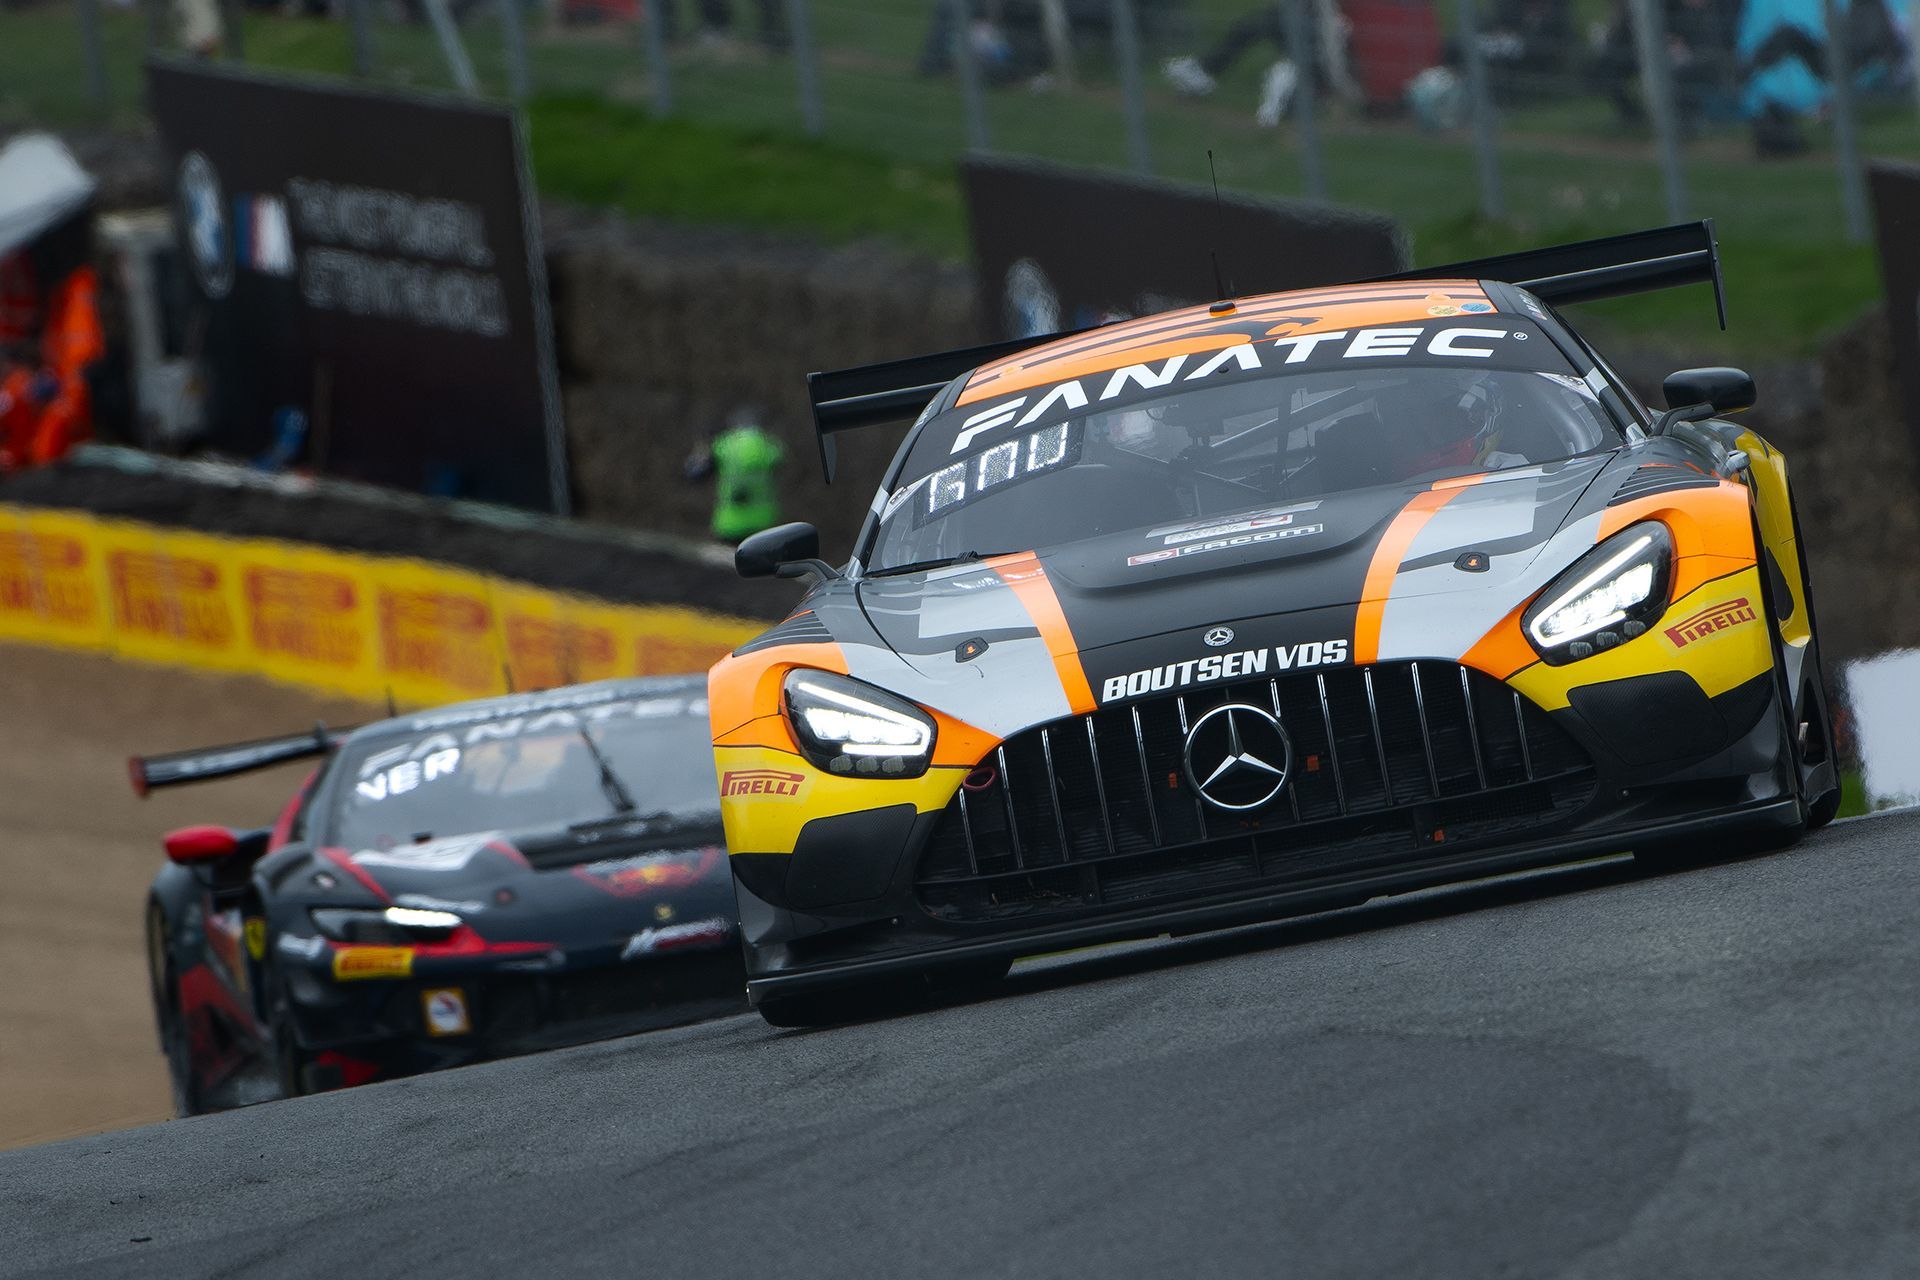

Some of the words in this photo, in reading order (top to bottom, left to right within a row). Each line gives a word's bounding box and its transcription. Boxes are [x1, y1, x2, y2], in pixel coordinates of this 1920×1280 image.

[1664, 597, 1757, 648] PIRELLI
[1102, 648, 1268, 703] BOUTSEN
[1276, 639, 1348, 670] VDS
[355, 748, 461, 801] VER
[721, 769, 806, 797] PIRELLI
